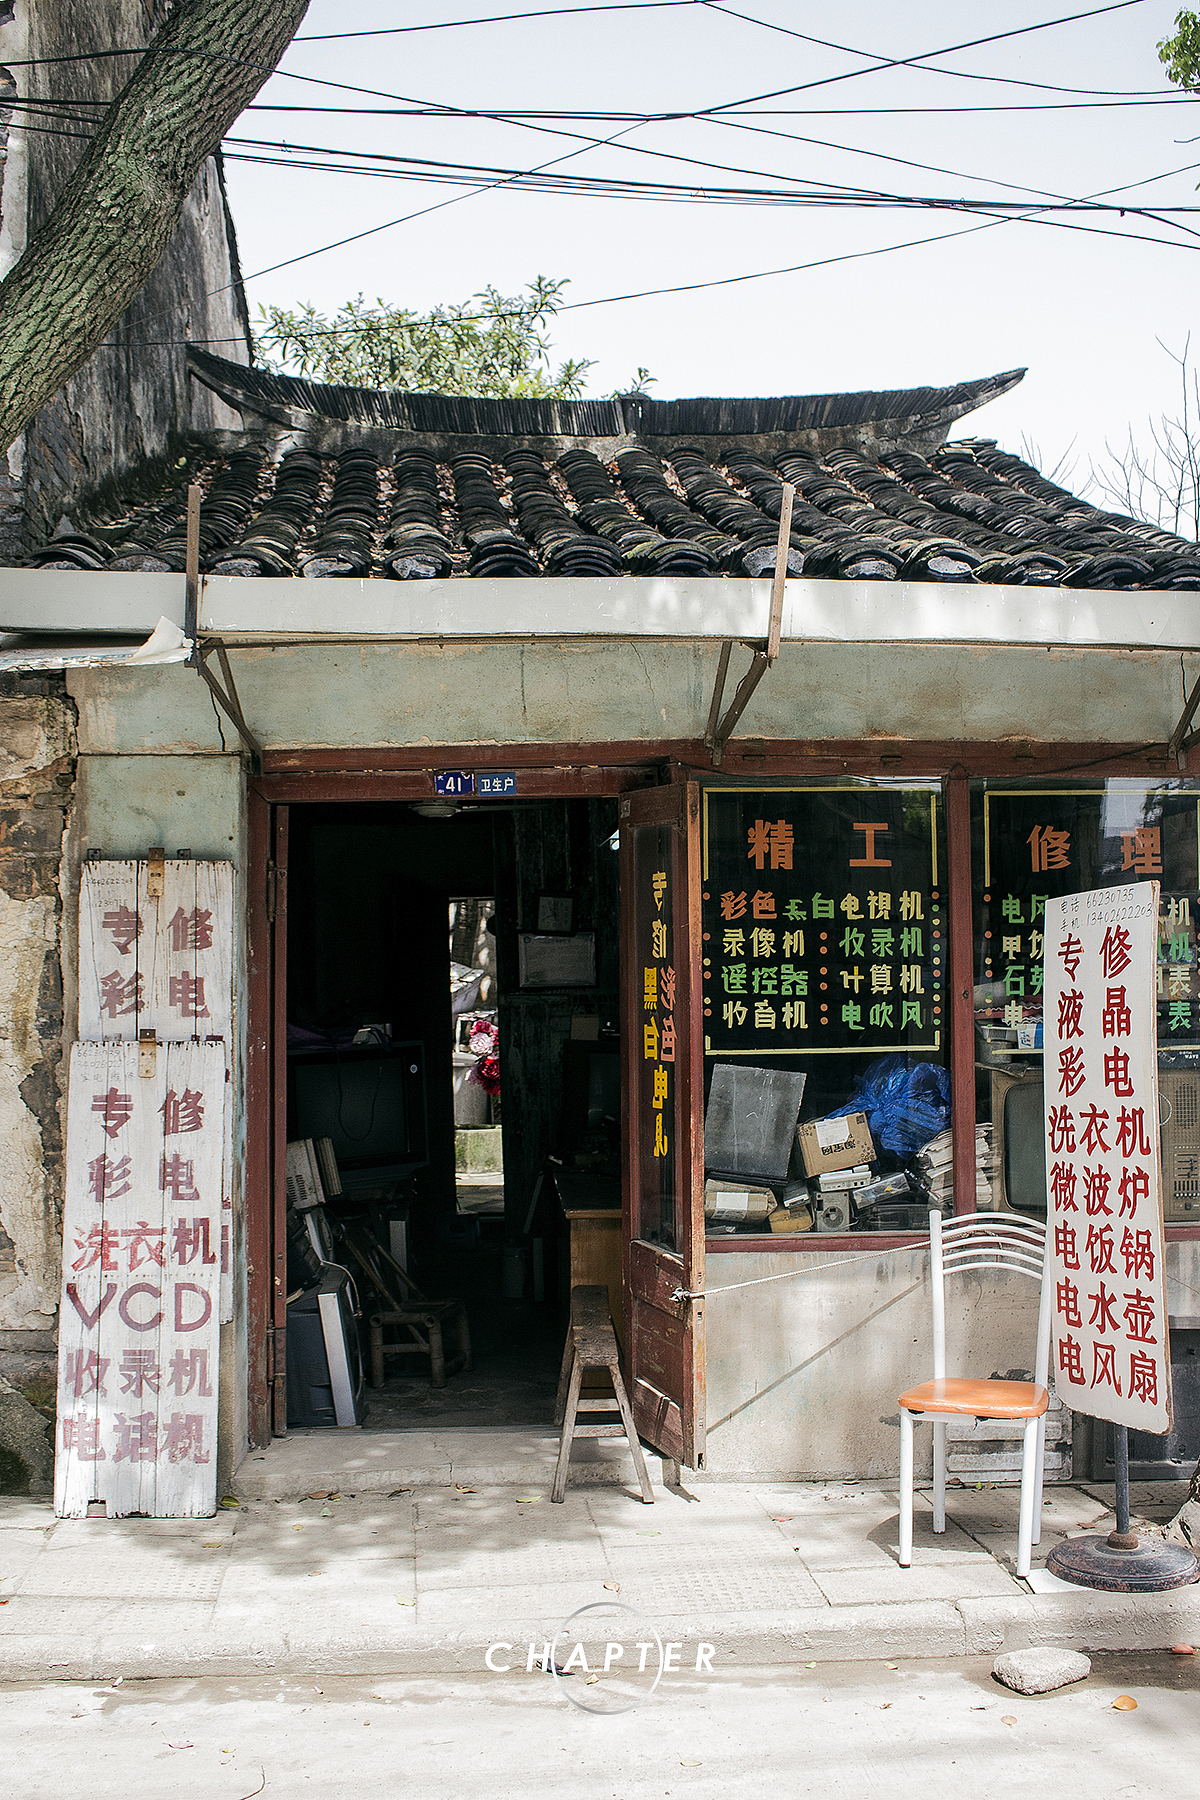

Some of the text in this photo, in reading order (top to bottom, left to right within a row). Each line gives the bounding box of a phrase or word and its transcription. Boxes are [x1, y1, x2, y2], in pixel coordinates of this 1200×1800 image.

[445, 776, 461, 792] 41
[480, 776, 514, 792] 卫生户
[747, 818, 892, 870] 精工
[1026, 824, 1163, 874] 修理
[1086, 888, 1135, 909] 66230735
[1086, 902, 1154, 927] 13402622203
[102, 905, 214, 956] 专修
[722, 926, 925, 958] 录像机 收录机
[1057, 924, 1133, 983] 专修
[100, 969, 211, 1019] 彩电
[721, 963, 809, 995] 遥控器
[722, 999, 923, 1030] 收音机 电吹风
[1057, 985, 1132, 1041] 液晶
[1058, 1045, 1134, 1099] 彩电
[91, 1086, 205, 1138] 专修
[1048, 1103, 1152, 1159] 洗衣机
[87, 1152, 201, 1203] 彩电
[1049, 1160, 1150, 1219] 微波炉
[71, 1216, 217, 1273] 洗衣机
[1054, 1219, 1155, 1283] 电饭锅
[66, 1282, 213, 1333] VCD
[1056, 1275, 1158, 1345] 电水壶
[65, 1348, 213, 1398] 收录机
[1058, 1332, 1158, 1407] 电风扇
[63, 1410, 210, 1464] 电话机
